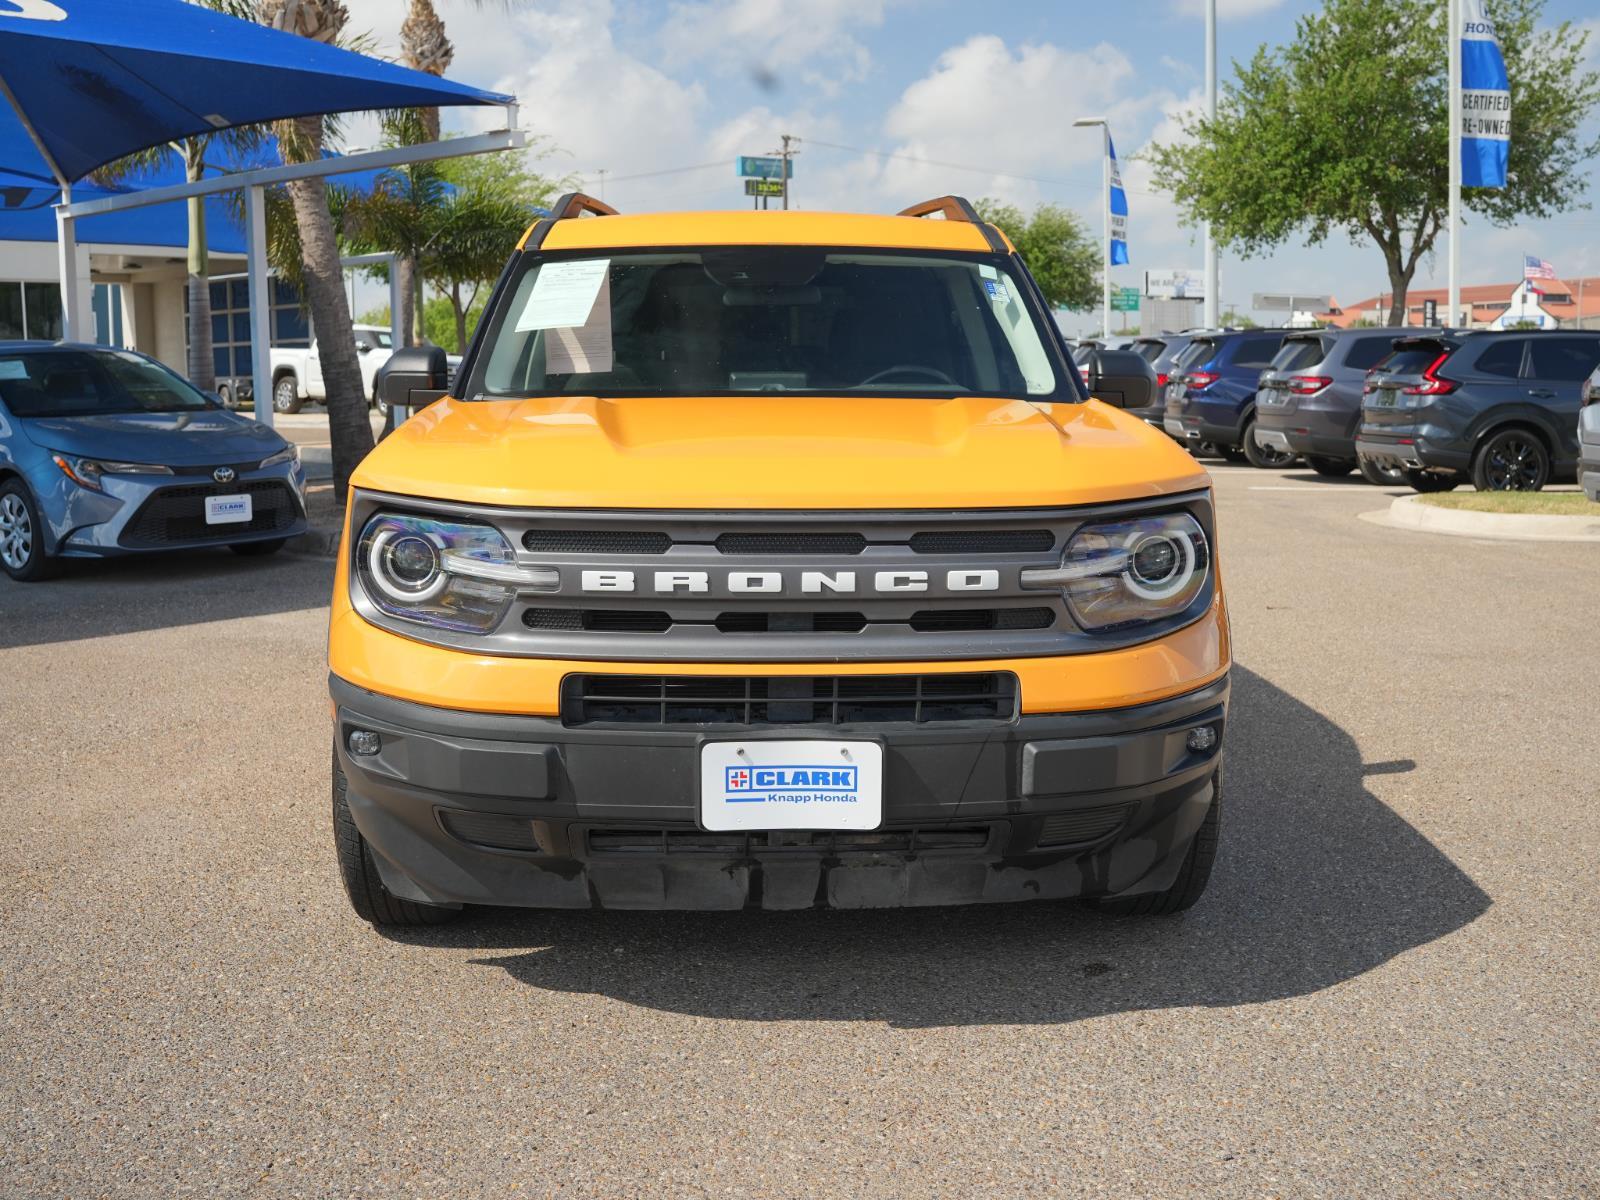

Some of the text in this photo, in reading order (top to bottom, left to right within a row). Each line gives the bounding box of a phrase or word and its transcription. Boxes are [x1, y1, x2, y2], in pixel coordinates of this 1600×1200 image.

[1462, 94, 1509, 111] CERTIFIED
[581, 570, 1000, 593] BRONCO
[756, 771, 851, 787] CLARK
[768, 793, 857, 804] Knapp Honda
